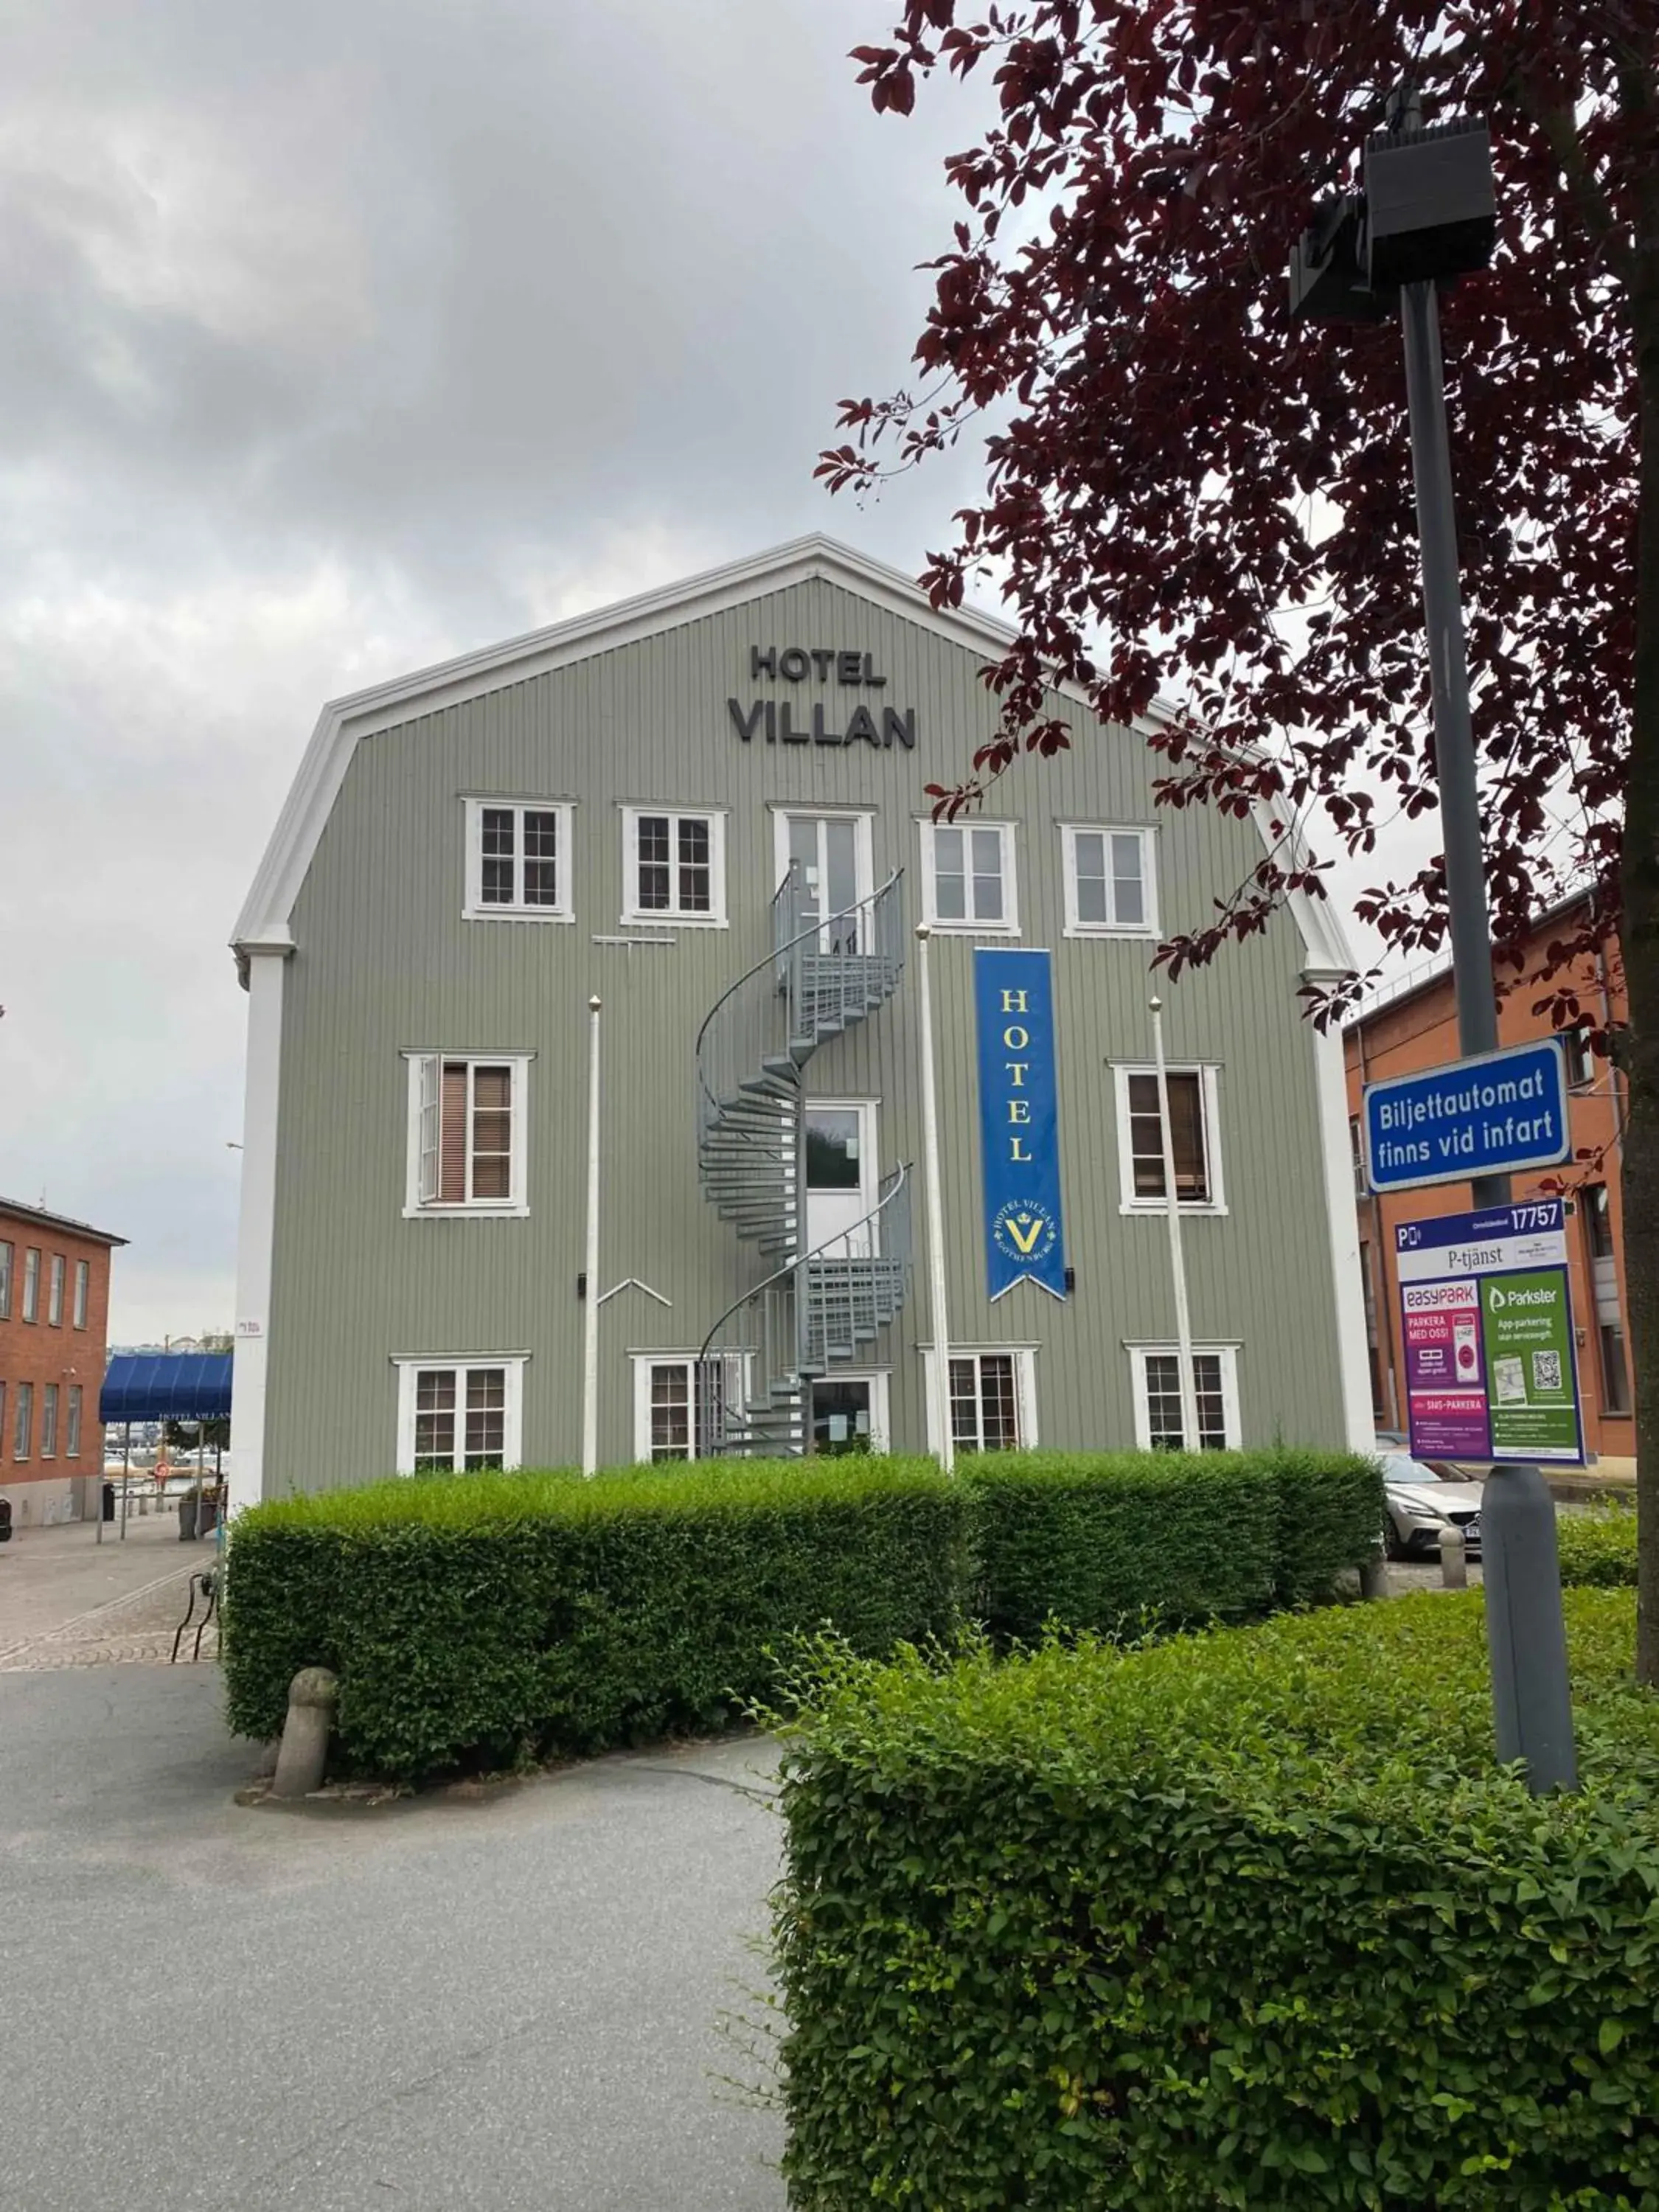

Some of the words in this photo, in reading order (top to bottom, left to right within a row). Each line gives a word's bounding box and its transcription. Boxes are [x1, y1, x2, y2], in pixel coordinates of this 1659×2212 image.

[751, 644, 887, 686] HOTEL
[728, 698, 915, 749] VILLAN
[1000, 989, 1032, 1161] HOTEL
[1379, 1068, 1543, 1131] Biljettautomat
[1378, 1141, 1430, 1169] finns
[1438, 1124, 1475, 1157] vid
[1482, 1110, 1553, 1150] infart
[993, 1199, 1023, 1230] HOTEL
[1023, 1199, 1056, 1230] VILLAN
[1511, 1203, 1558, 1231] 17757
[1004, 1218, 1044, 1253] V
[1448, 1246, 1503, 1270] P-tjänst
[1508, 1287, 1557, 1307] Parkster
[1408, 1315, 1447, 1328] PARKERA
[1409, 1328, 1427, 1340] MED
